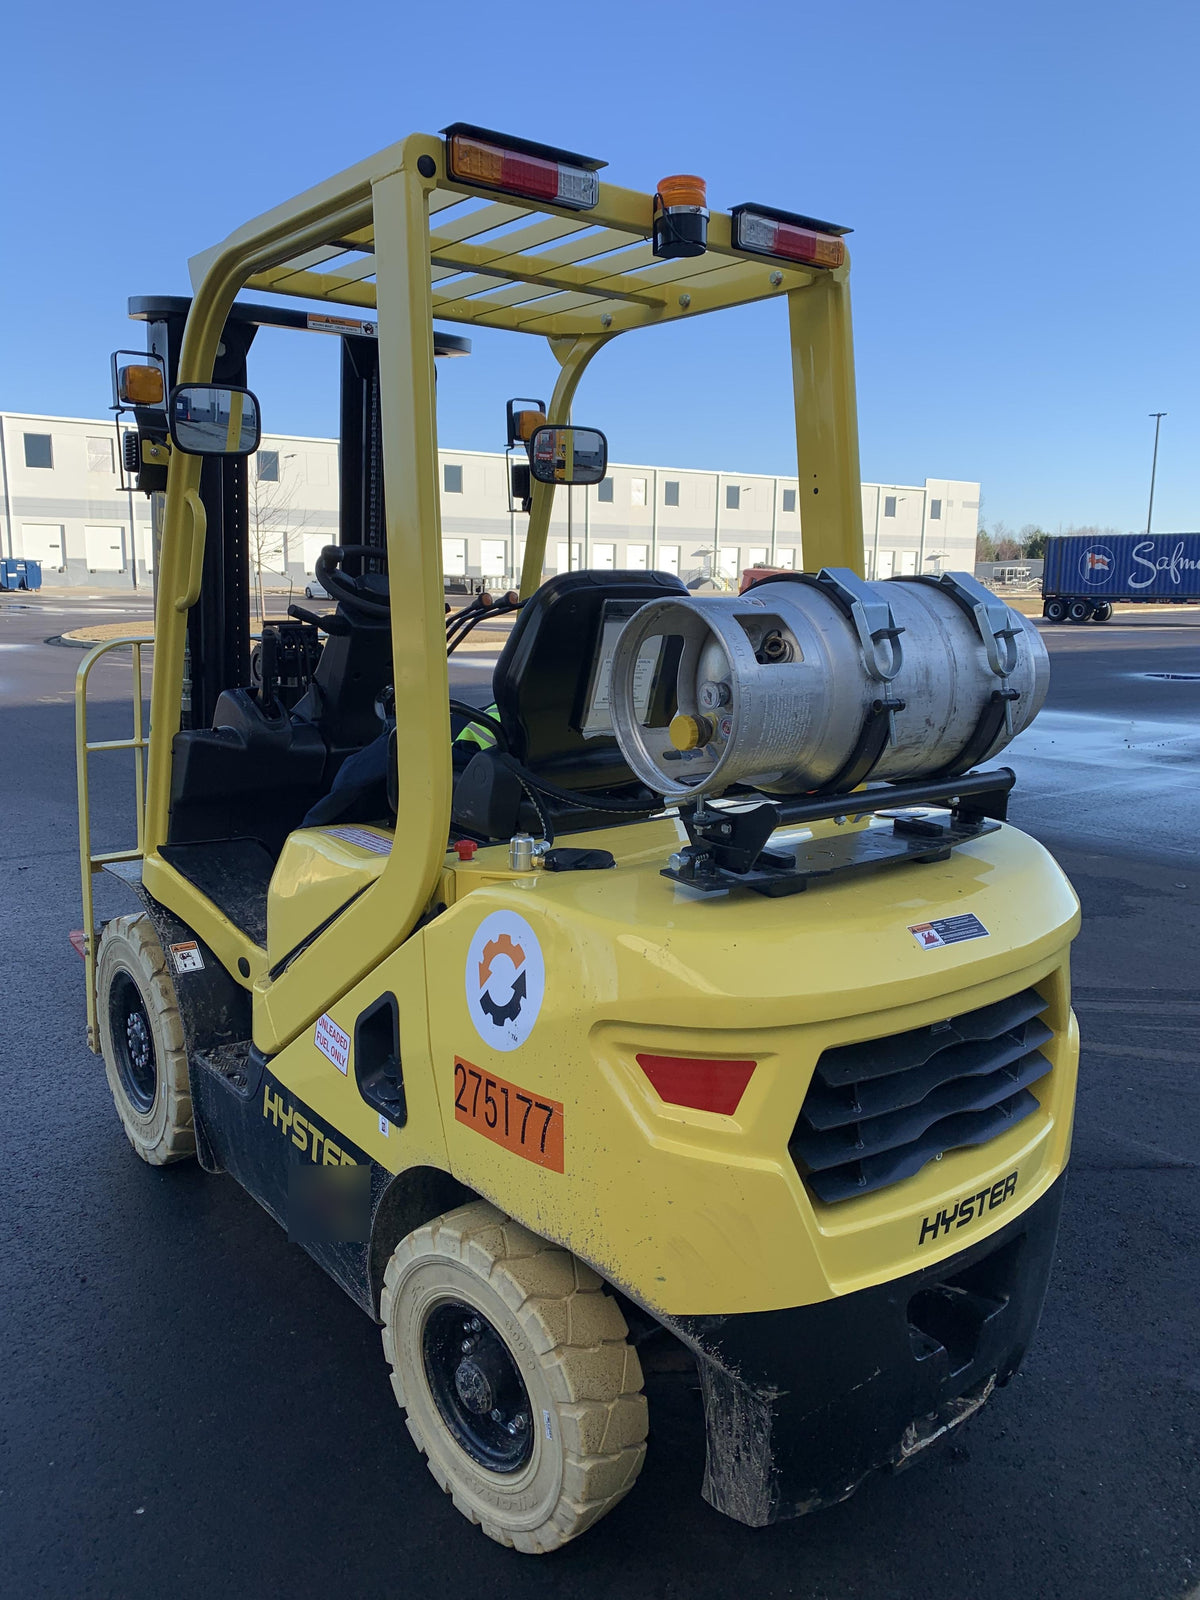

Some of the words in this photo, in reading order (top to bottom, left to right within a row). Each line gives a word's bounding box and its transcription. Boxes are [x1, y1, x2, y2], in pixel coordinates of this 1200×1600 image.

[317, 1030, 330, 1053] FUEL
[330, 1045, 347, 1067] ONLY
[318, 1017, 348, 1050] UNLEADED
[263, 1084, 358, 1166] HYSTE
[454, 1063, 553, 1153] 275177
[918, 1171, 1018, 1245] HYSTER
